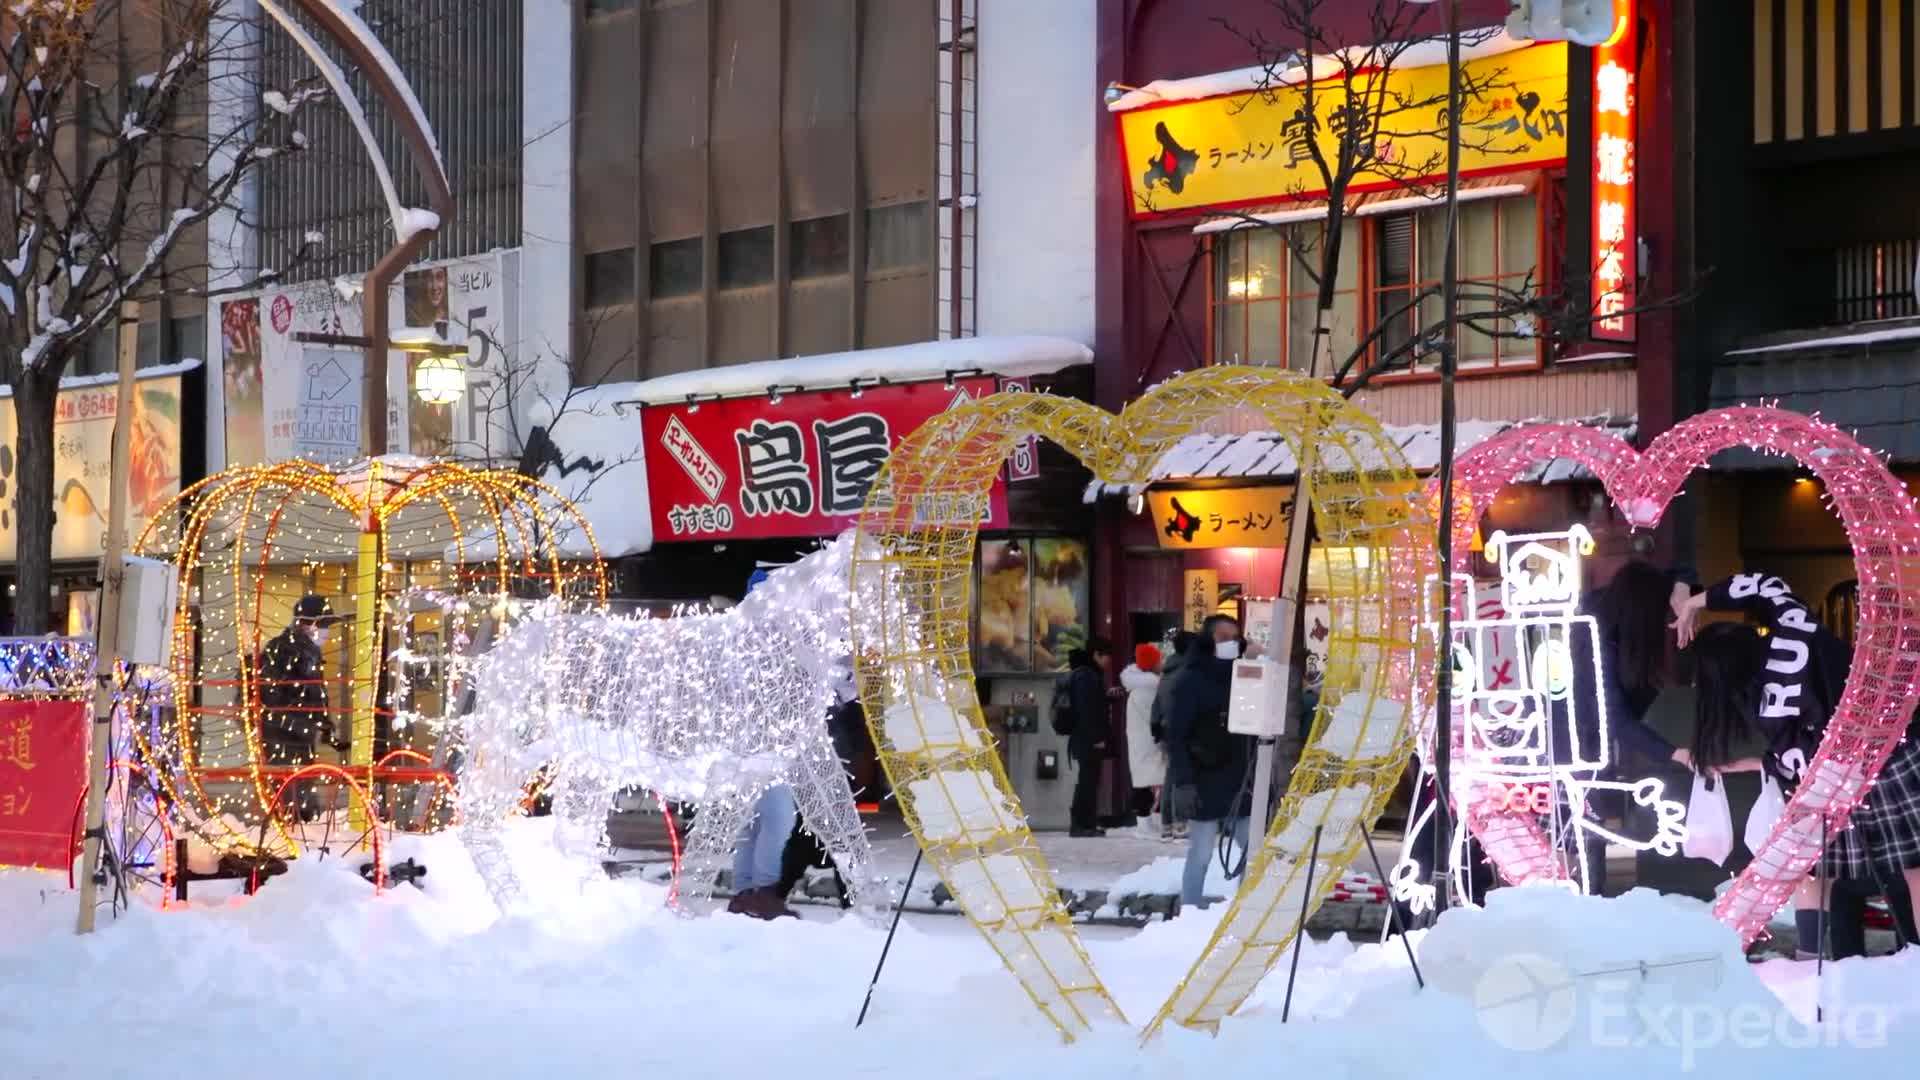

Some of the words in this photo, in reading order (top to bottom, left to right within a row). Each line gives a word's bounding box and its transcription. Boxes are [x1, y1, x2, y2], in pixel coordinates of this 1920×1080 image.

[1209, 142, 1274, 168] ラーメン
[460, 271, 493, 293] 当ビル
[667, 504, 734, 535] すすきの
[1209, 512, 1273, 532] ラーメン
